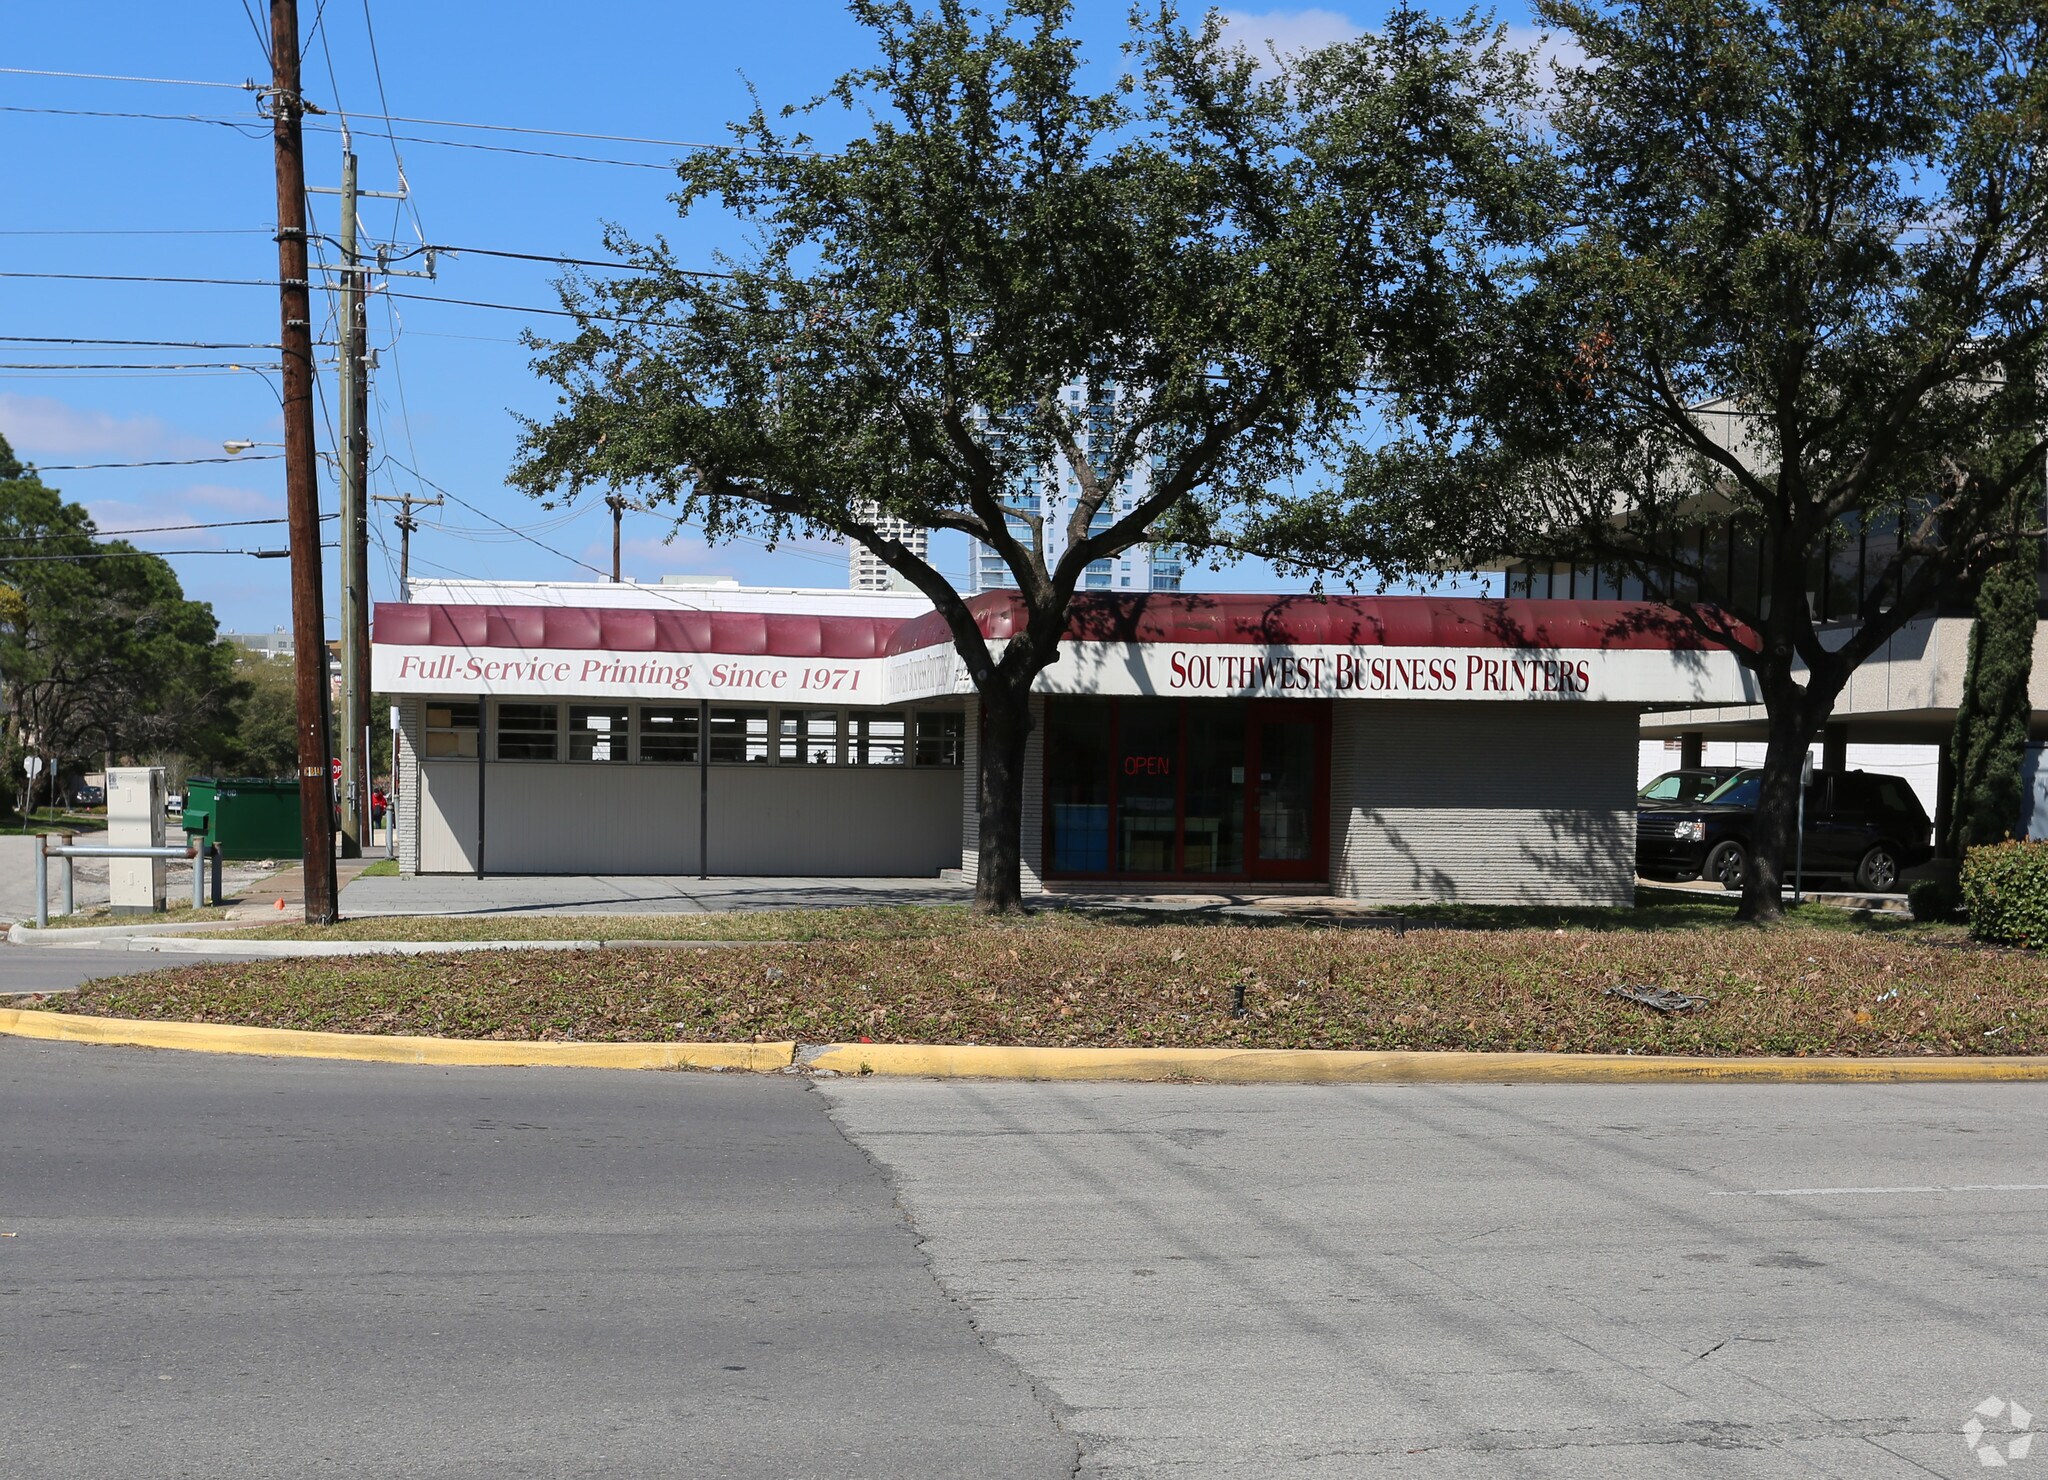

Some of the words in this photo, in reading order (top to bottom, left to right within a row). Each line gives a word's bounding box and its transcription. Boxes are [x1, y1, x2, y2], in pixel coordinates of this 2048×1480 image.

[398, 654, 571, 682] Full-Service
[578, 658, 693, 691] Printing
[708, 662, 788, 689] Since
[799, 667, 862, 691] 1971
[1169, 650, 1326, 690] SOUTHWEST
[1334, 653, 1457, 691] BUSINESS
[1465, 655, 1590, 693] PRINTERS
[1124, 756, 1169, 775] OPEN
